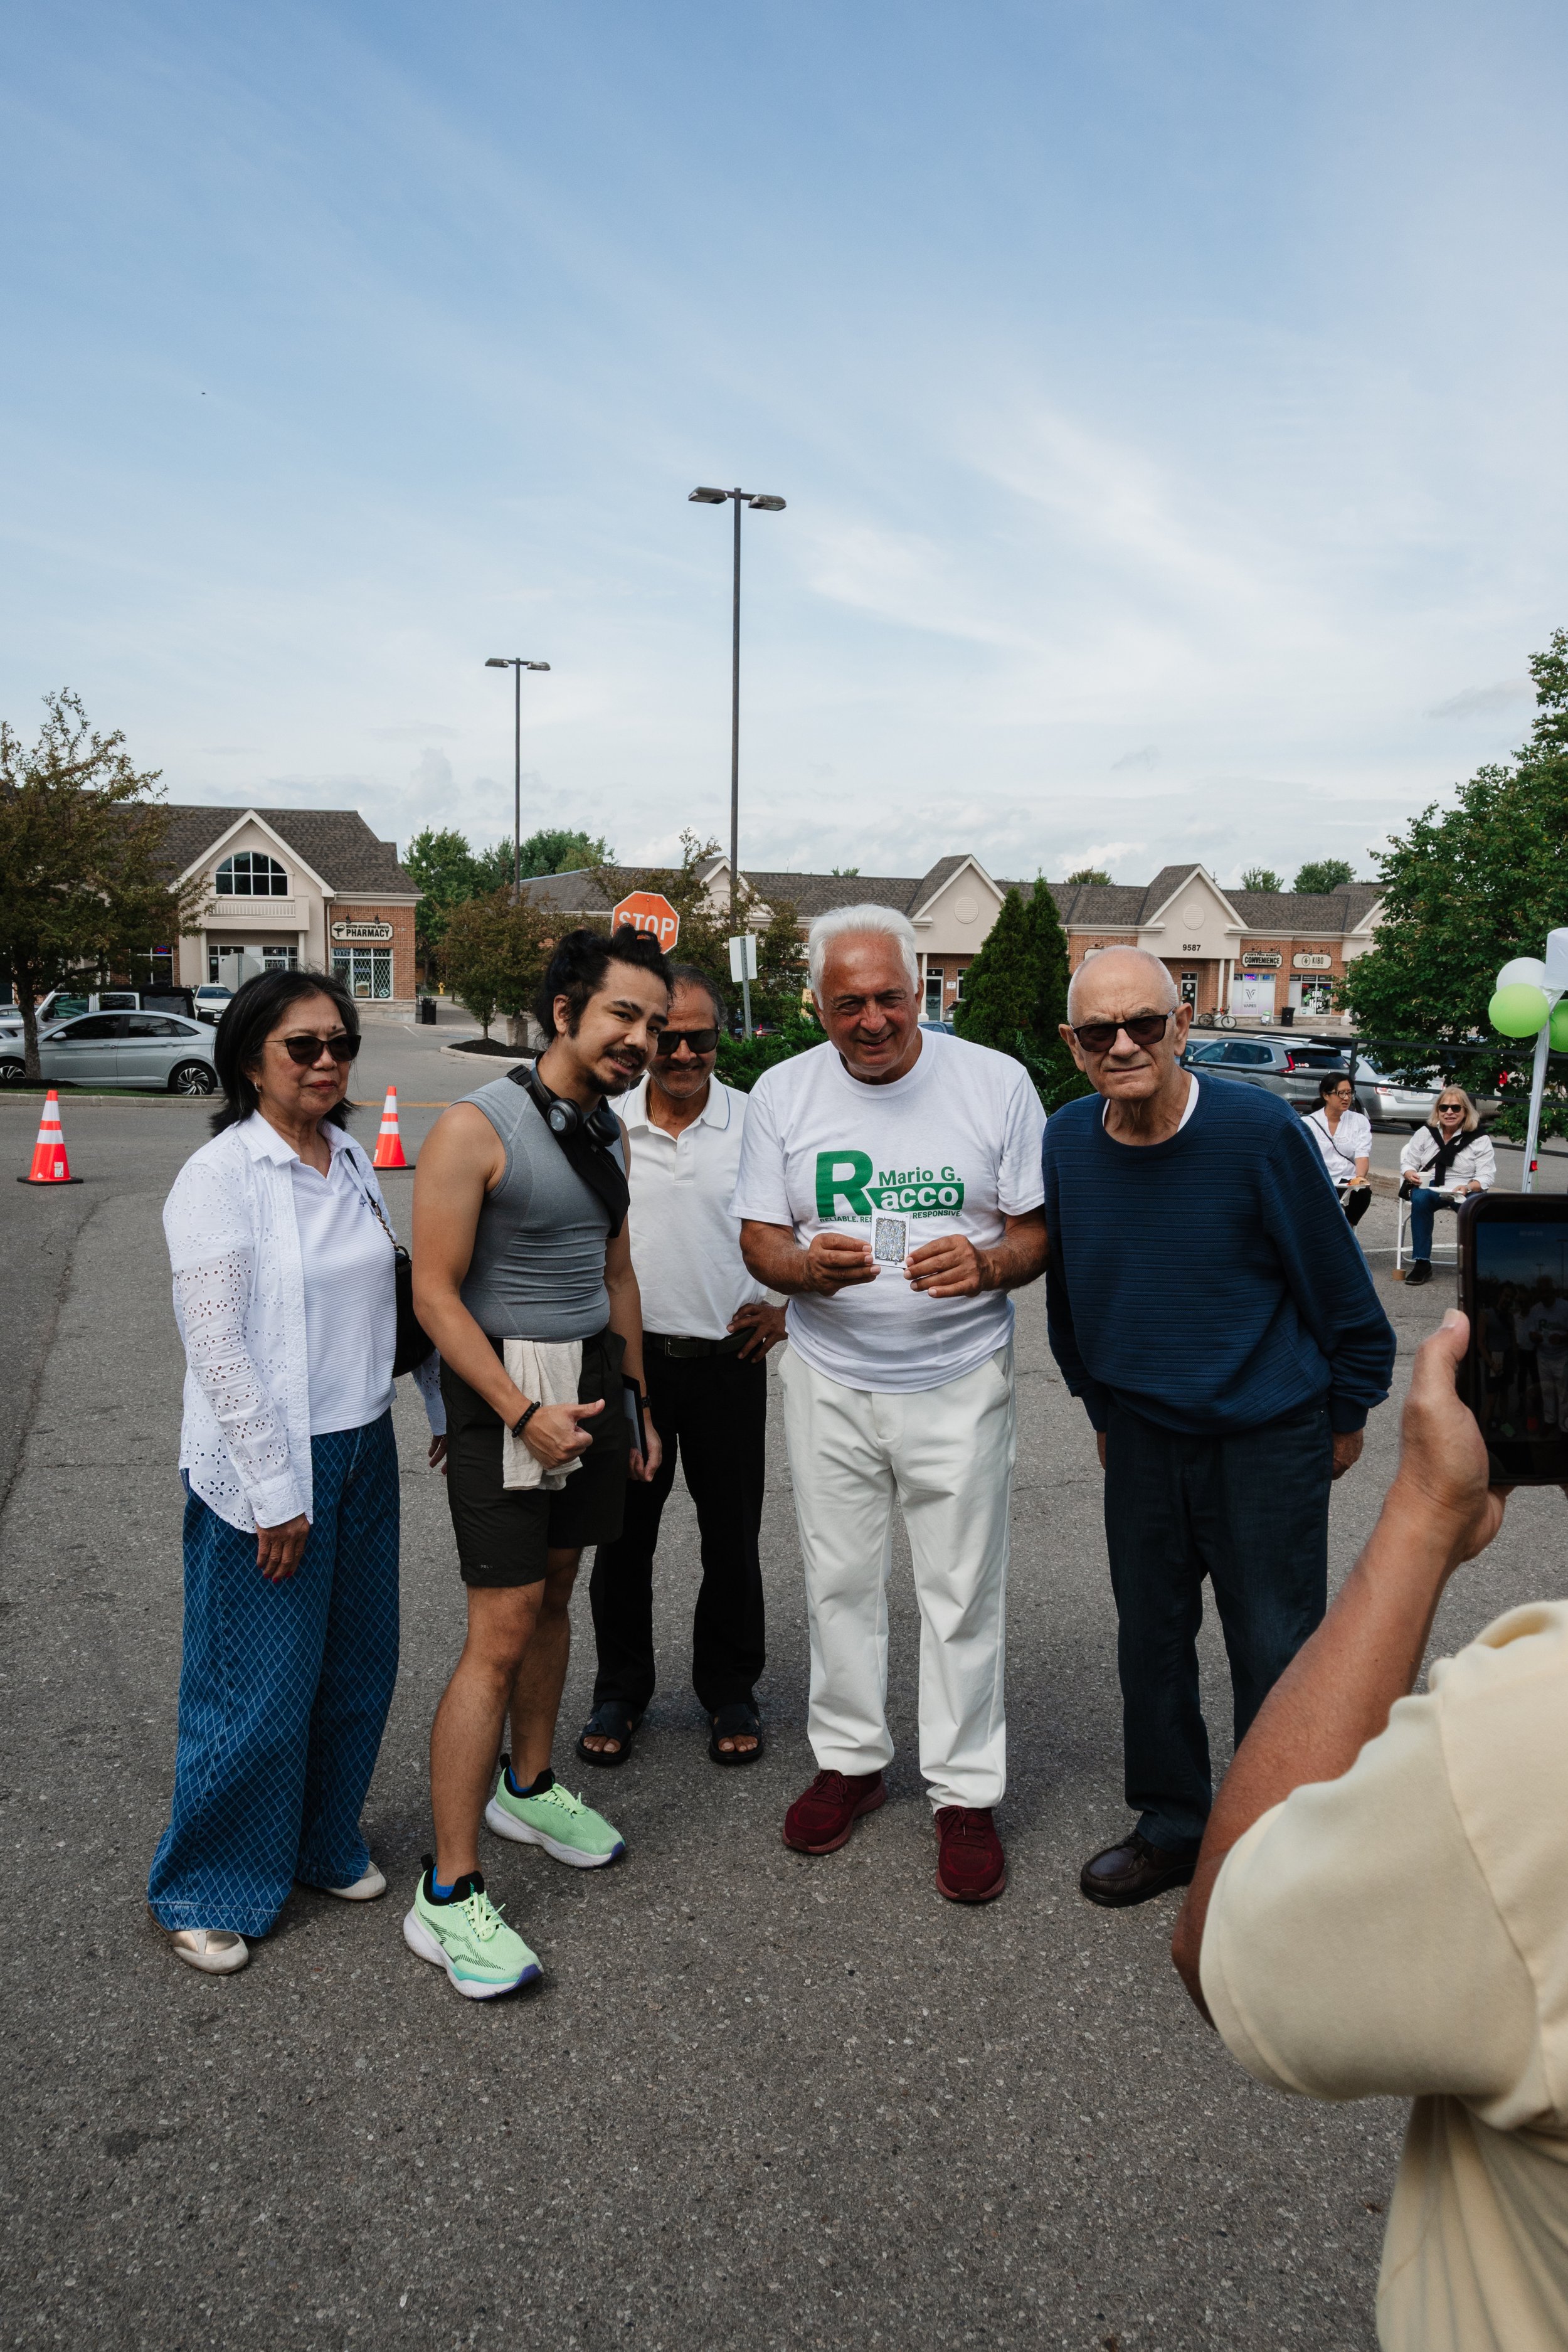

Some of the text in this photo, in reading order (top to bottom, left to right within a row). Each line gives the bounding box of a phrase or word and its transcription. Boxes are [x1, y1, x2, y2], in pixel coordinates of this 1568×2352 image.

[619, 911, 675, 940] STOP
[346, 929, 389, 937] PHARMACY
[1312, 956, 1324, 965] KIBO
[879, 1166, 961, 1186] Mario G.
[913, 1210, 962, 1219] RESPONSIVE.
